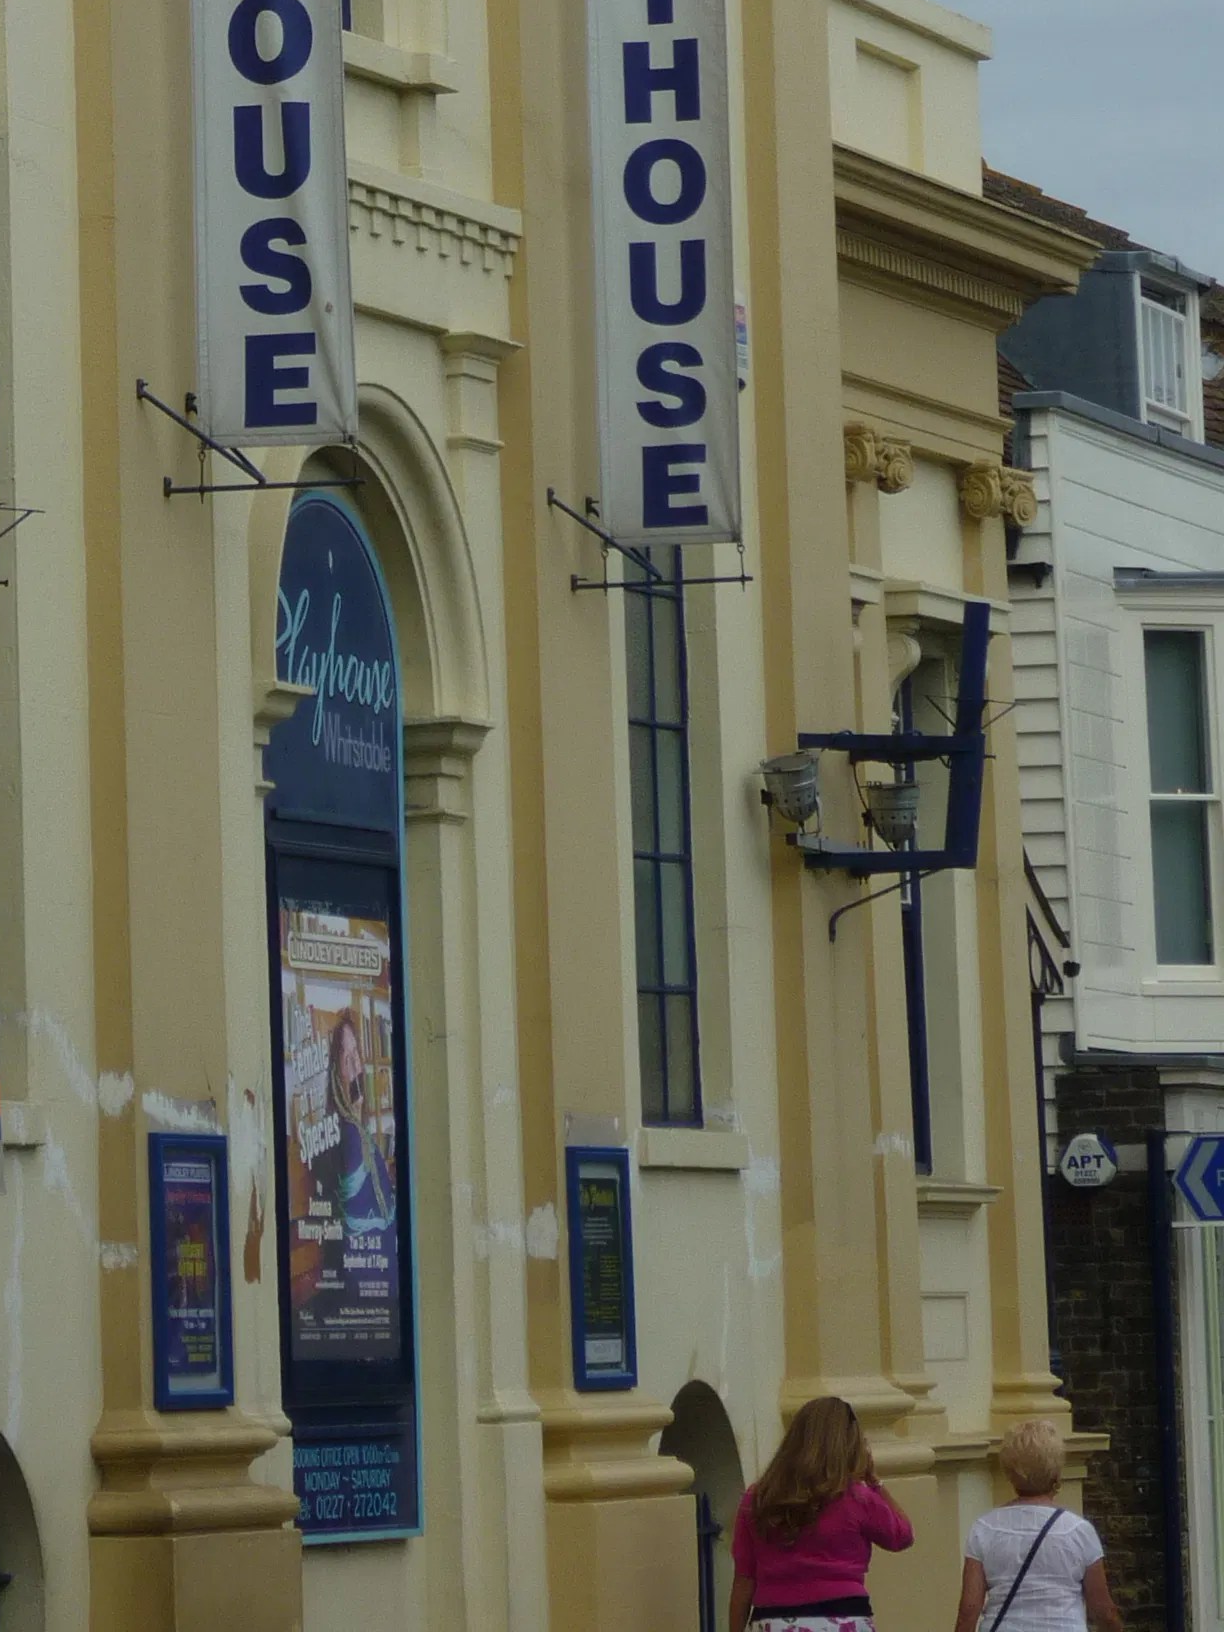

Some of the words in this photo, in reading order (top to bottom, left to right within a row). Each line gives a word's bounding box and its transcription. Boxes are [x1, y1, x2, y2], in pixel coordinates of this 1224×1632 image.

[323, 711, 392, 773] Whitstable
[290, 938, 333, 964] LINDLEY
[334, 944, 379, 969] PLAYERS
[298, 1112, 341, 1170] Species
[1067, 1154, 1105, 1169] APT
[304, 1470, 341, 1492] MONDAY
[350, 1468, 392, 1490] SATURDAY
[316, 1493, 345, 1521] 01227
[353, 1491, 398, 1518] 272042
